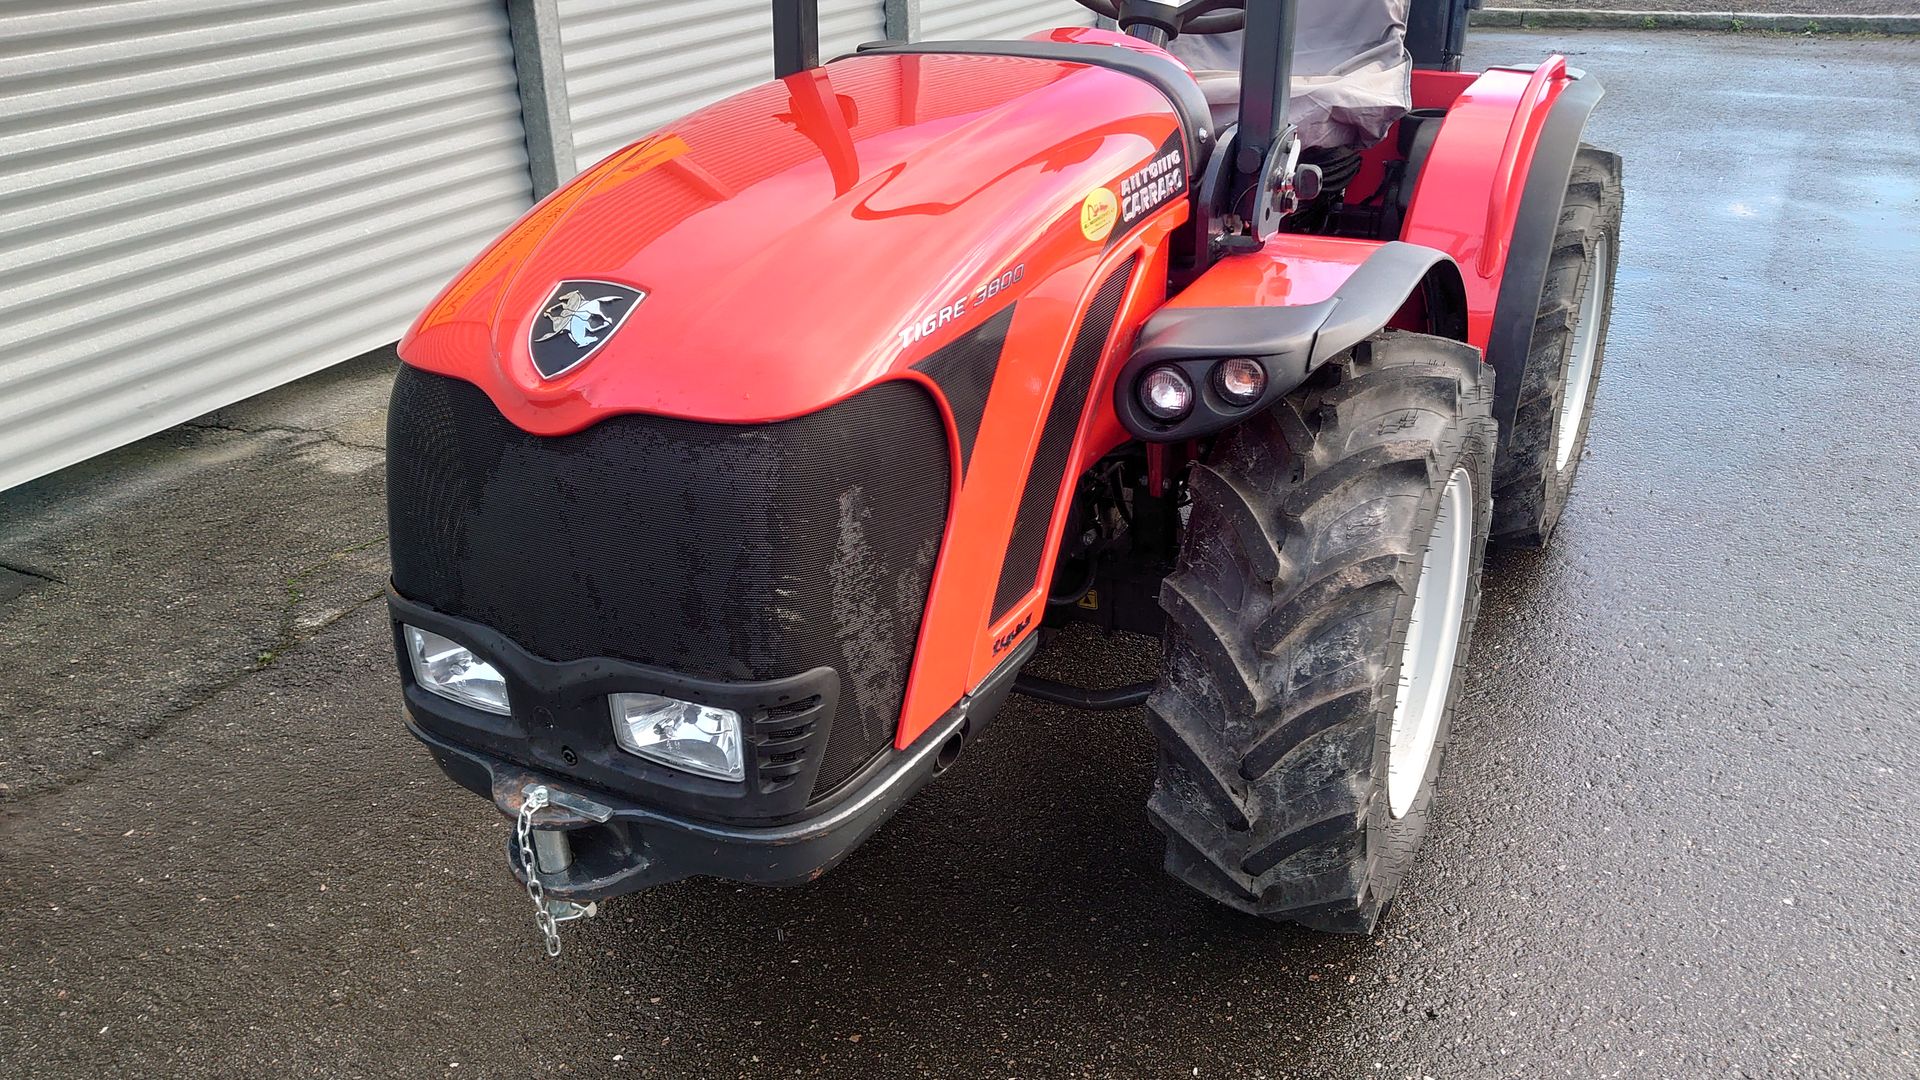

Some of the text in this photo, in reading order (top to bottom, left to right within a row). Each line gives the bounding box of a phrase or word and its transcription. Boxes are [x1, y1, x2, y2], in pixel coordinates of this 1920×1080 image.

[1122, 168, 1182, 222] CARRARO
[898, 263, 1025, 348] TIGRE 3800
